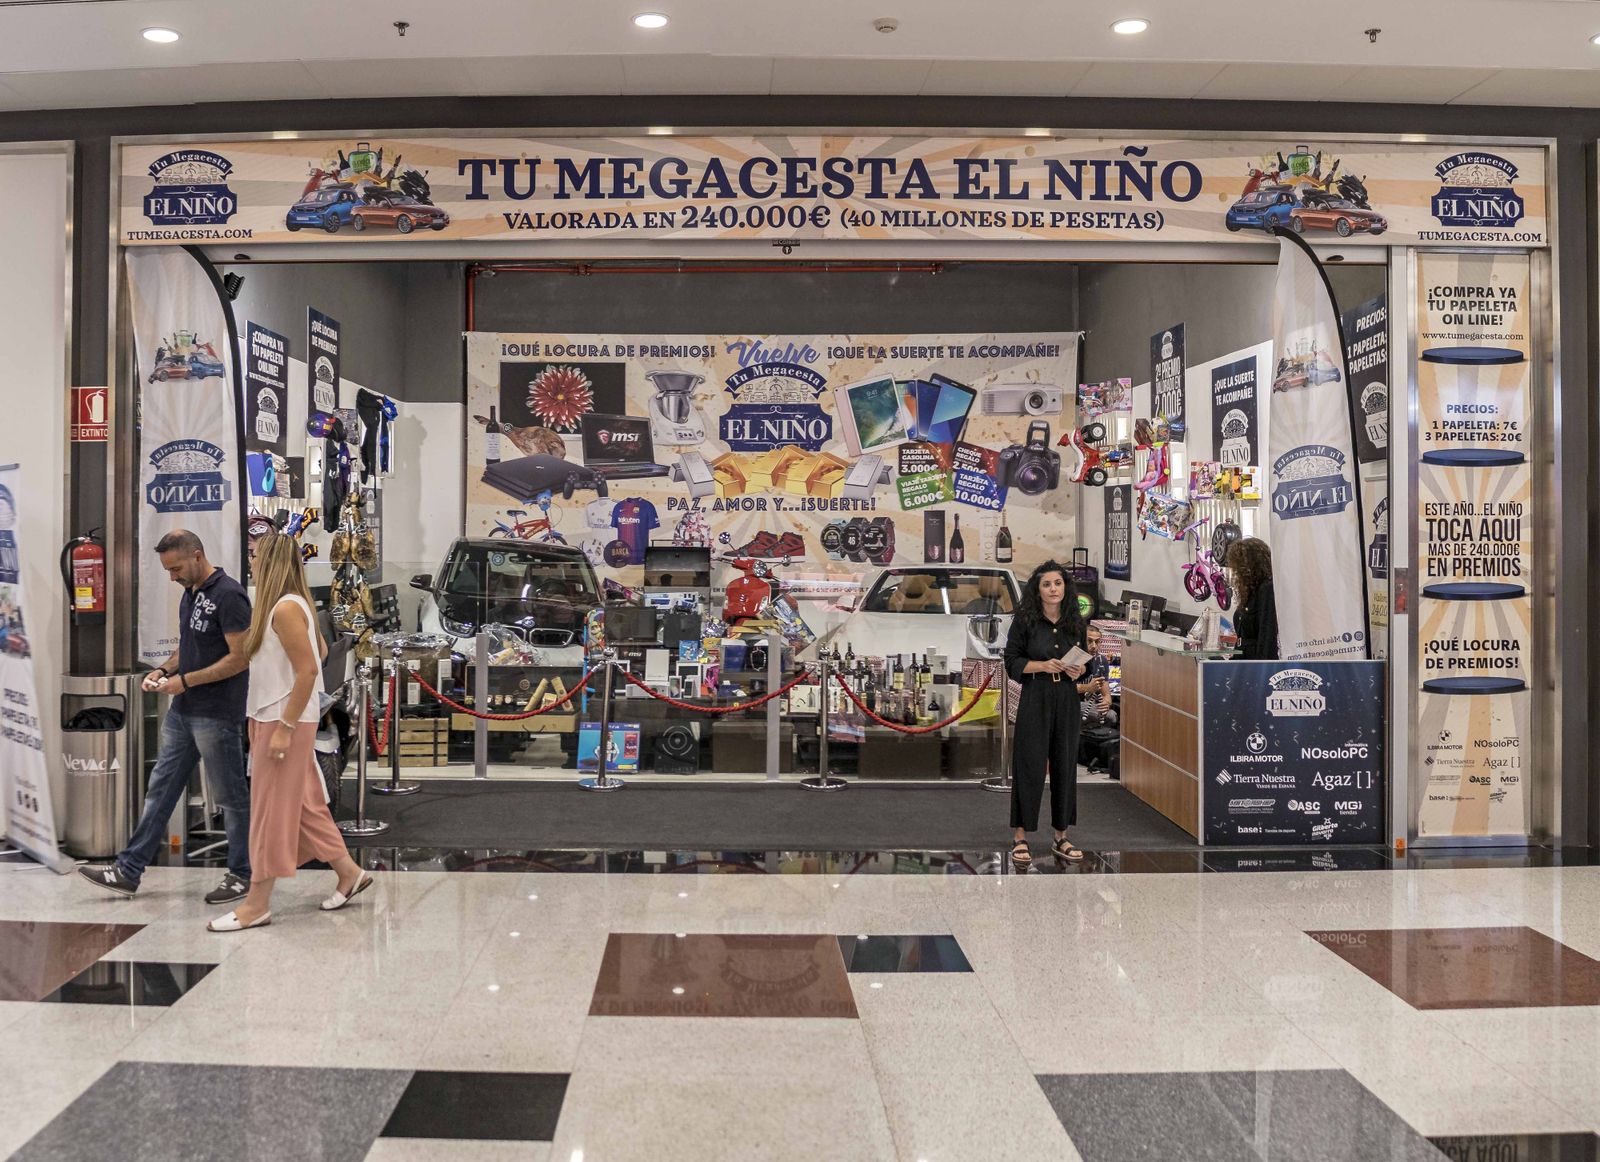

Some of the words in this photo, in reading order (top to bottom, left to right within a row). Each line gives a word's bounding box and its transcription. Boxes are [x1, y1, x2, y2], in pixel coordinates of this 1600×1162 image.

[151, 157, 167, 172] Tu
[170, 150, 230, 171] Megacesta
[1438, 159, 1455, 173] Tu
[1456, 154, 1514, 173] Megacesta
[457, 158, 541, 200] TU
[553, 157, 941, 200] MEGACESTA
[952, 158, 1029, 200] EL
[1043, 145, 1203, 202] NIÑO
[176, 192, 233, 216] NIÑO
[1465, 196, 1520, 218] NIÑO
[502, 212, 639, 230] VALORADA
[643, 212, 676, 229] EN
[681, 205, 831, 230] 240.000€
[840, 208, 876, 230] (40
[880, 210, 1007, 228] MILLONES
[1011, 211, 1045, 228] DE
[1050, 210, 1165, 231] PESETAS)
[127, 228, 253, 241] TUMEGACESTA.COM
[1417, 230, 1542, 242] TUMEGACESTA.COM
[1428, 286, 1494, 300] ¡COMPRA
[1499, 287, 1517, 299] YA
[1428, 300, 1446, 311] TU
[1450, 300, 1518, 312] PAPELETA
[1442, 313, 1464, 325] ON
[1468, 314, 1503, 326] LINE!
[1422, 332, 1524, 341] www.tumegacesta.com
[252, 343, 260, 357] TU
[260, 346, 284, 366] PAPELETA
[502, 343, 540, 357] ¡QUÉ
[544, 344, 611, 357] LOCURA
[615, 345, 635, 357] DE
[640, 345, 716, 358] PREMIOS!
[726, 339, 821, 368] Vuelve
[827, 346, 865, 359] ¡QUE
[868, 346, 887, 358] LA
[891, 346, 944, 359] SUERTE
[948, 345, 964, 358] TE
[968, 342, 1060, 358] ACOMPAÑE!
[730, 374, 748, 387] Tu
[752, 364, 820, 386] Megacesta
[1227, 376, 1234, 388] LA
[1234, 370, 1255, 385] SUERTE
[1215, 395, 1222, 406] TE
[1446, 404, 1499, 414] PRECIOS:
[726, 419, 759, 441] EL
[761, 414, 828, 441] NIÑO
[1432, 421, 1438, 430] 1
[1442, 421, 1500, 430] PAPELETA:
[1503, 421, 1518, 431] 7€
[81, 429, 108, 437] EXTINTO
[611, 432, 640, 443] msi
[1425, 432, 1432, 441] 3
[1435, 432, 1500, 442] PAPELETAS:
[1500, 433, 1522, 442] 20€
[956, 453, 980, 463] REGALO
[957, 447, 982, 458] CHEQUE
[1222, 450, 1230, 465] EL
[901, 464, 939, 473] 3.000€
[902, 483, 927, 493] REGALO
[958, 480, 985, 491] REGALO
[667, 498, 708, 513] PAZ,
[712, 497, 767, 512] AMOR
[903, 491, 945, 507] 6.000€
[955, 489, 1000, 509] 10.000€
[1425, 502, 1450, 516] ESTE
[1498, 501, 1523, 516] NIÑO
[1425, 518, 1474, 542] TOCA
[1454, 543, 1466, 556] DE
[1470, 543, 1520, 556] 240.000€
[1427, 557, 1447, 577] EN
[1452, 557, 1521, 577] PREMIOS
[1424, 637, 1459, 654] ¡QUÉ
[1463, 639, 1521, 651] LOCURA
[1425, 658, 1444, 669] DE
[1448, 657, 1519, 669] PREMIOS!
[1271, 699, 1288, 710] EL
[1289, 697, 1323, 710] NIÑO
[1255, 755, 1283, 763] MOTOR
[1301, 747, 1368, 760] NOsoloPC
[1483, 757, 1509, 769] Agaz
[1233, 774, 1261, 783] Tierra
[1261, 773, 1296, 783] Nuestra
[1311, 771, 1352, 791] Agaz
